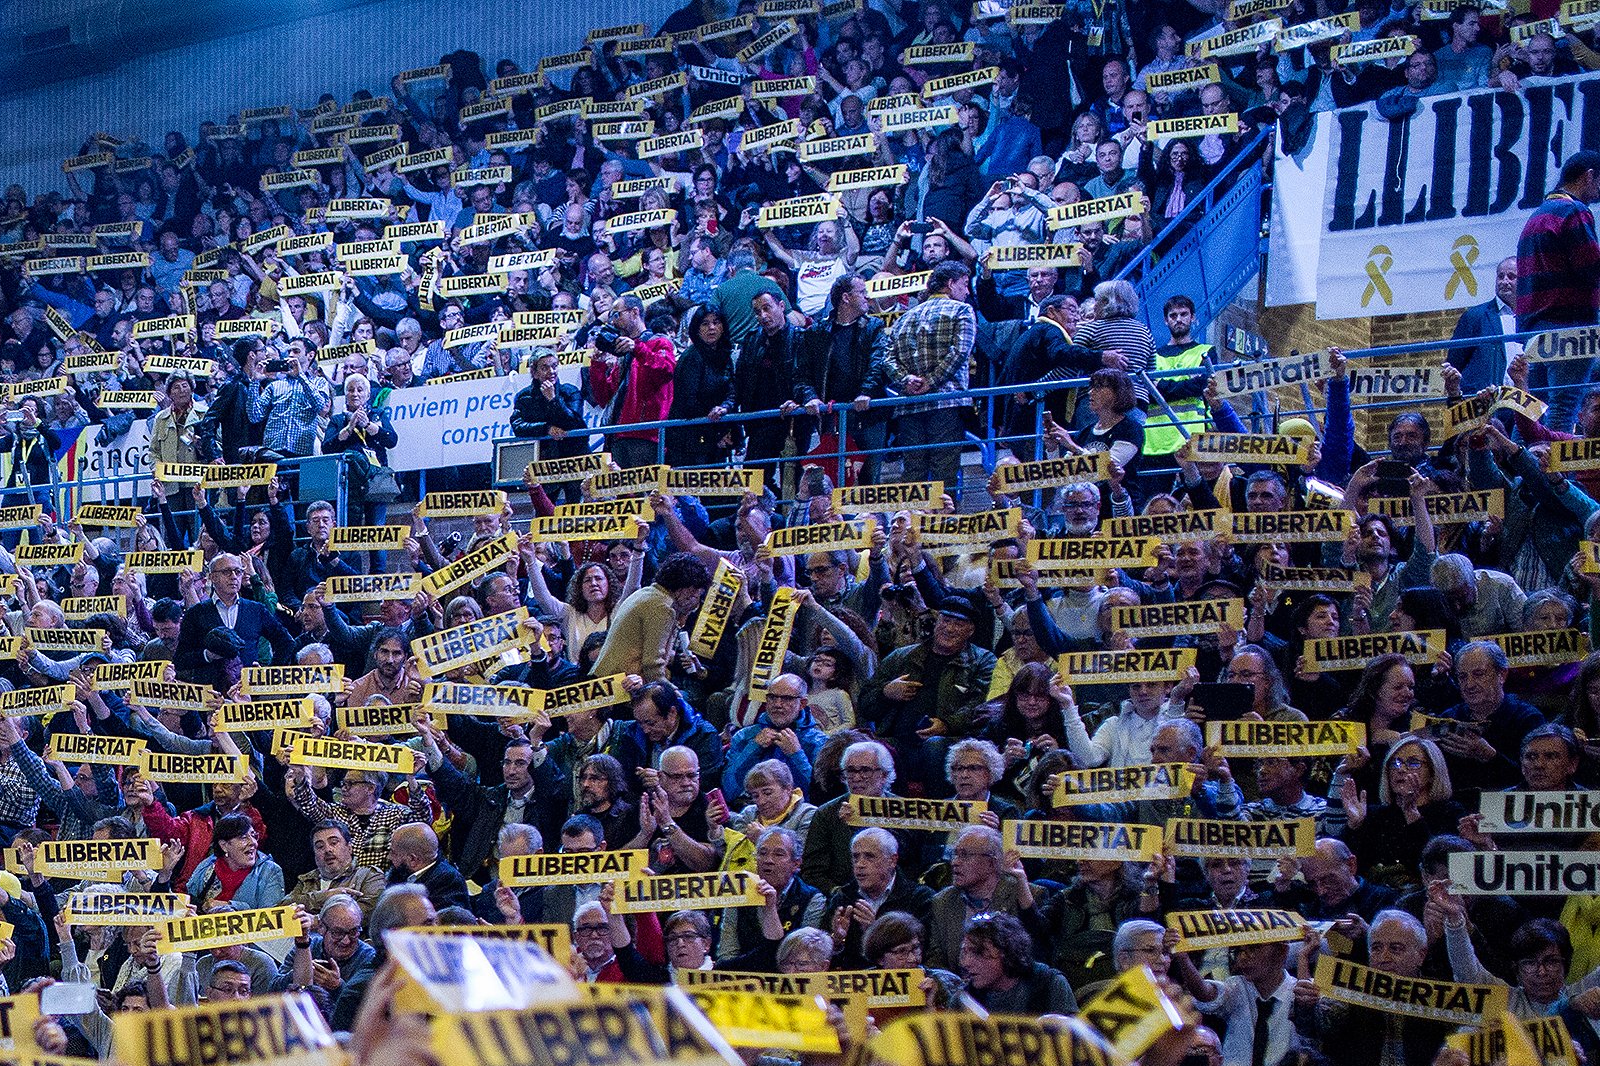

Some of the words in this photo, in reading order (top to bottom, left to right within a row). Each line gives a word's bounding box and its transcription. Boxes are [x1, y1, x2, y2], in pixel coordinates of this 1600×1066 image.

[1337, 40, 1407, 59] LLIBERTAT
[630, 75, 682, 98] LLIBERTAT
[700, 67, 740, 84] Unita
[1155, 115, 1228, 135] LLIBERTAT
[1328, 76, 1600, 232] LLIBE
[766, 202, 830, 220] LLIBERTAT
[1056, 194, 1134, 221] LLIBERTAT
[245, 227, 286, 249] LLIBERTAT
[1538, 329, 1600, 358] Unit
[1227, 354, 1320, 393] Unitat!
[1351, 369, 1431, 394] nitat!
[383, 396, 459, 421] anviem
[464, 391, 515, 418] pres
[441, 419, 516, 446] constr
[1196, 434, 1300, 455] LLIBERTAT
[1004, 453, 1103, 484] LLIBERTAT
[842, 483, 932, 504] LLIBERTAT
[773, 520, 866, 547] LLIBERTAT
[919, 508, 1009, 536] LLIBERTAT
[1110, 510, 1216, 538] LLIBERTAT
[1232, 510, 1345, 536] LLIBERTAT
[333, 527, 401, 545] LLIBERTAT
[129, 552, 195, 569] LLIBERTAT
[433, 536, 510, 589] LLIBERTAT
[1038, 538, 1146, 562] LLIBERTAT
[332, 575, 412, 595] LLIBERTAT
[1118, 600, 1230, 626] LLIBERTAT
[1313, 632, 1428, 659] LLIBERTAT
[1504, 630, 1579, 658] IBERTAT
[96, 662, 163, 682] LLIBERTAT
[1068, 650, 1181, 676] LLIBERTAT
[248, 666, 333, 686] LLIBERTAT
[2, 686, 66, 710] LLIBERTAT
[134, 682, 204, 703] LLIBERTAT
[429, 683, 533, 708] LLIBERTAT
[543, 675, 614, 711] BERTAT
[223, 701, 302, 722] LLIBERTAT
[345, 706, 412, 727] LLIBERT
[55, 735, 136, 755] LLIBERTAT
[1220, 722, 1348, 747] LLIBERTAT
[148, 755, 236, 774] LLIBERTAT
[302, 740, 403, 764] LLIBERTAT
[1063, 763, 1181, 796] LLIBERTAT
[1015, 822, 1144, 850] LLIBERTAT
[1173, 821, 1298, 848] LLIBERTAT
[44, 840, 150, 863] LLIBERTAT
[513, 852, 635, 876] LLIBERTAT
[48, 861, 77, 870] PRESOS
[1474, 853, 1600, 891] Unita
[624, 874, 749, 902] LLIBERTAT
[71, 893, 178, 916] LLIBERTAT
[167, 909, 286, 943] LLIBERTAT
[1179, 911, 1297, 939] LLIBERTAT
[173, 940, 202, 949] PRESOS
[1331, 962, 1491, 1015] LLIBERTAT
